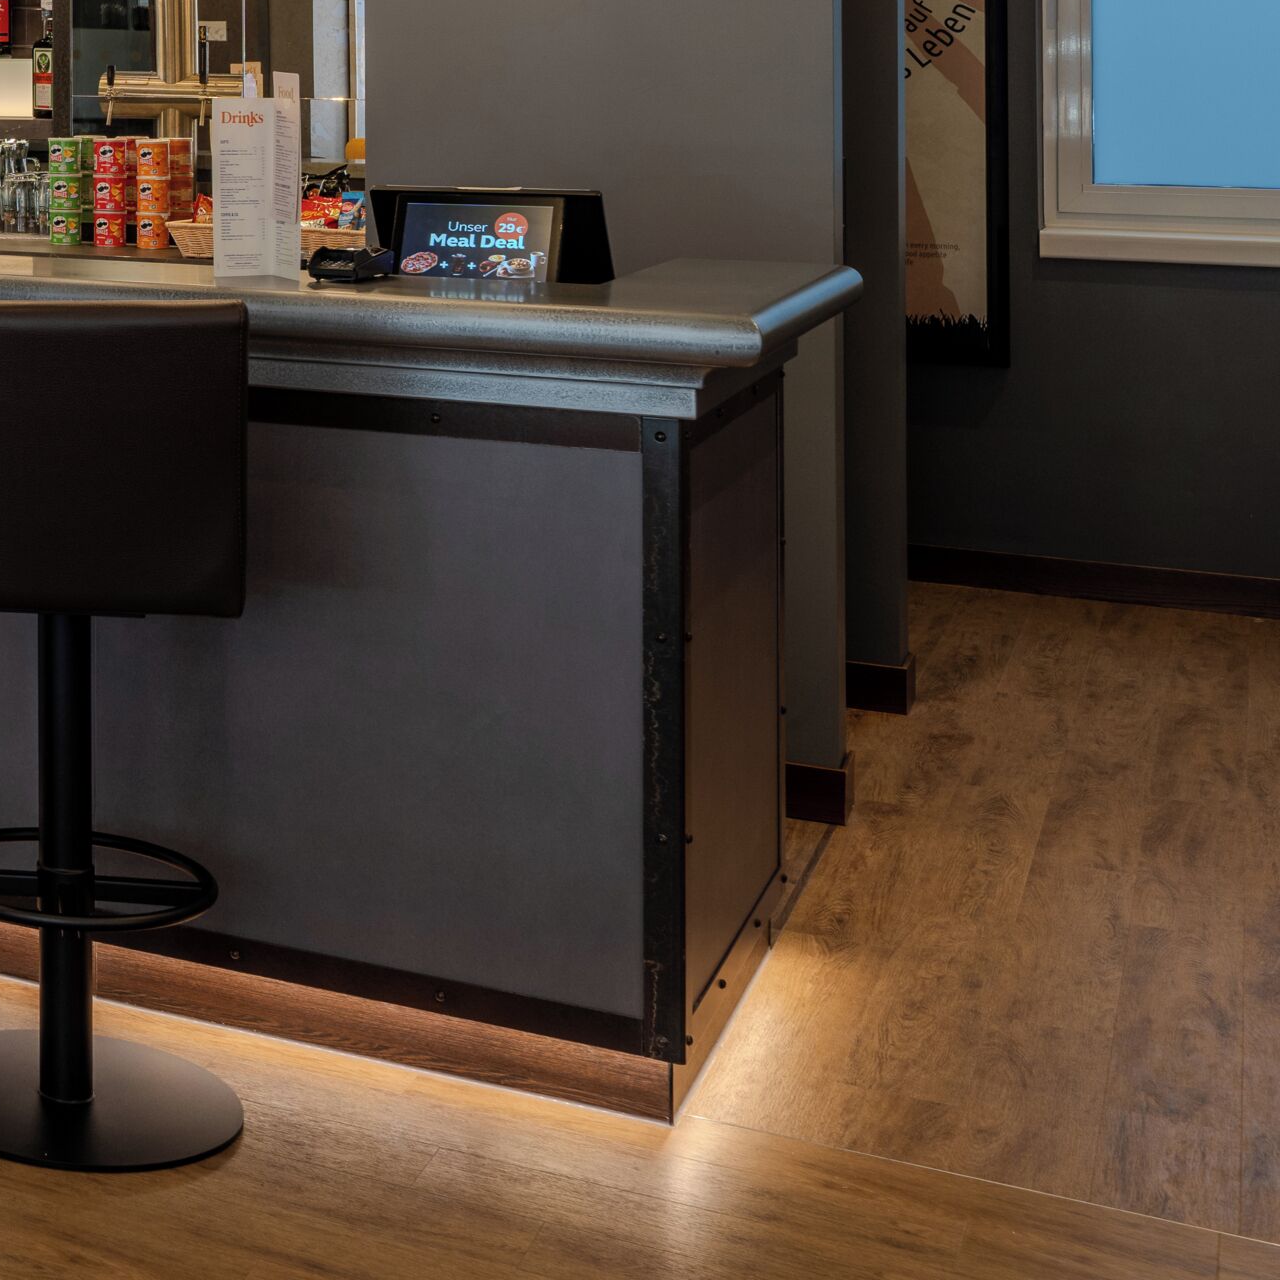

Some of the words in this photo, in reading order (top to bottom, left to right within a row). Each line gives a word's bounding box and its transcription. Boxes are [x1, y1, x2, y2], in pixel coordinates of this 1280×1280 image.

[906, 3, 976, 67] Leben
[278, 86, 296, 104] Food
[220, 111, 264, 127] Drinks
[448, 221, 488, 233] Unser
[429, 233, 477, 248] Meal
[480, 235, 525, 250] Deal
